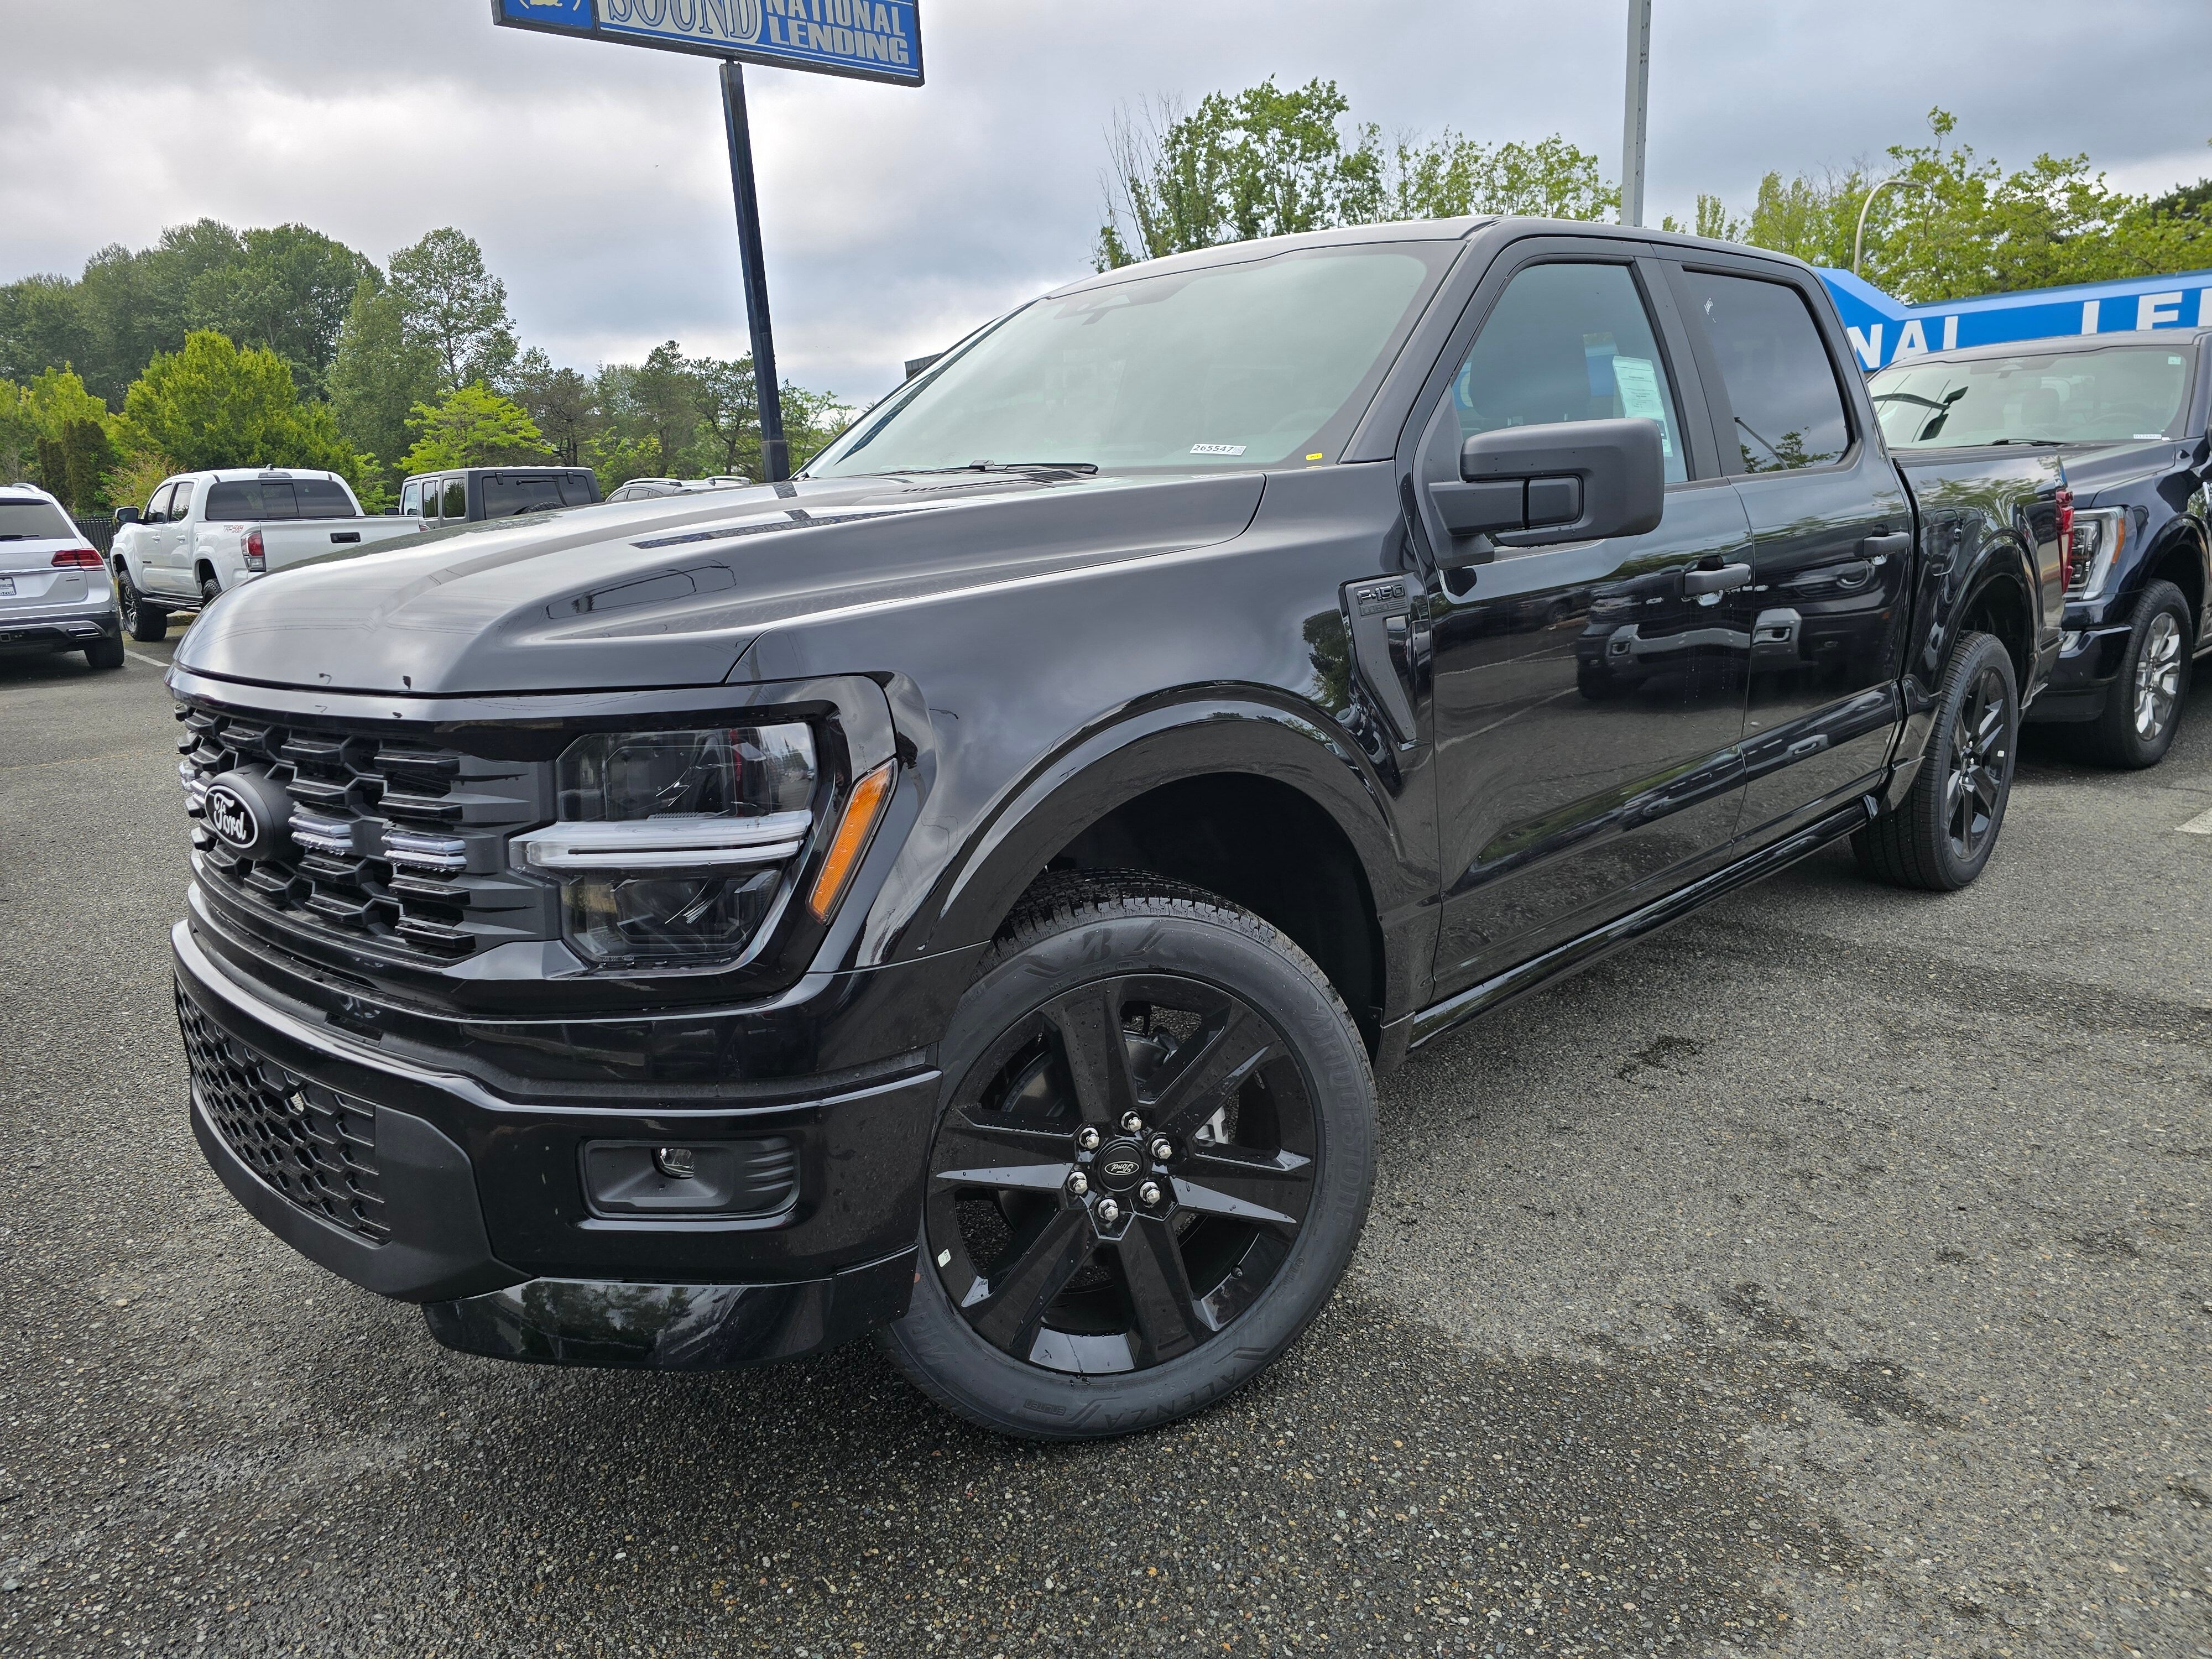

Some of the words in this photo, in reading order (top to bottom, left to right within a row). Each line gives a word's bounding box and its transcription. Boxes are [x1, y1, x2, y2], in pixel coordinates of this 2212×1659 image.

[768, 15, 909, 65] LENDING
[2081, 288, 2212, 334] LE
[1357, 585, 1406, 605] F-150
[213, 792, 247, 841] Ford
[1301, 1008, 1365, 1230] BRIDGESTONE
[1110, 1162, 1135, 1173] Ford
[1105, 1366, 1239, 1430] ALENZA
